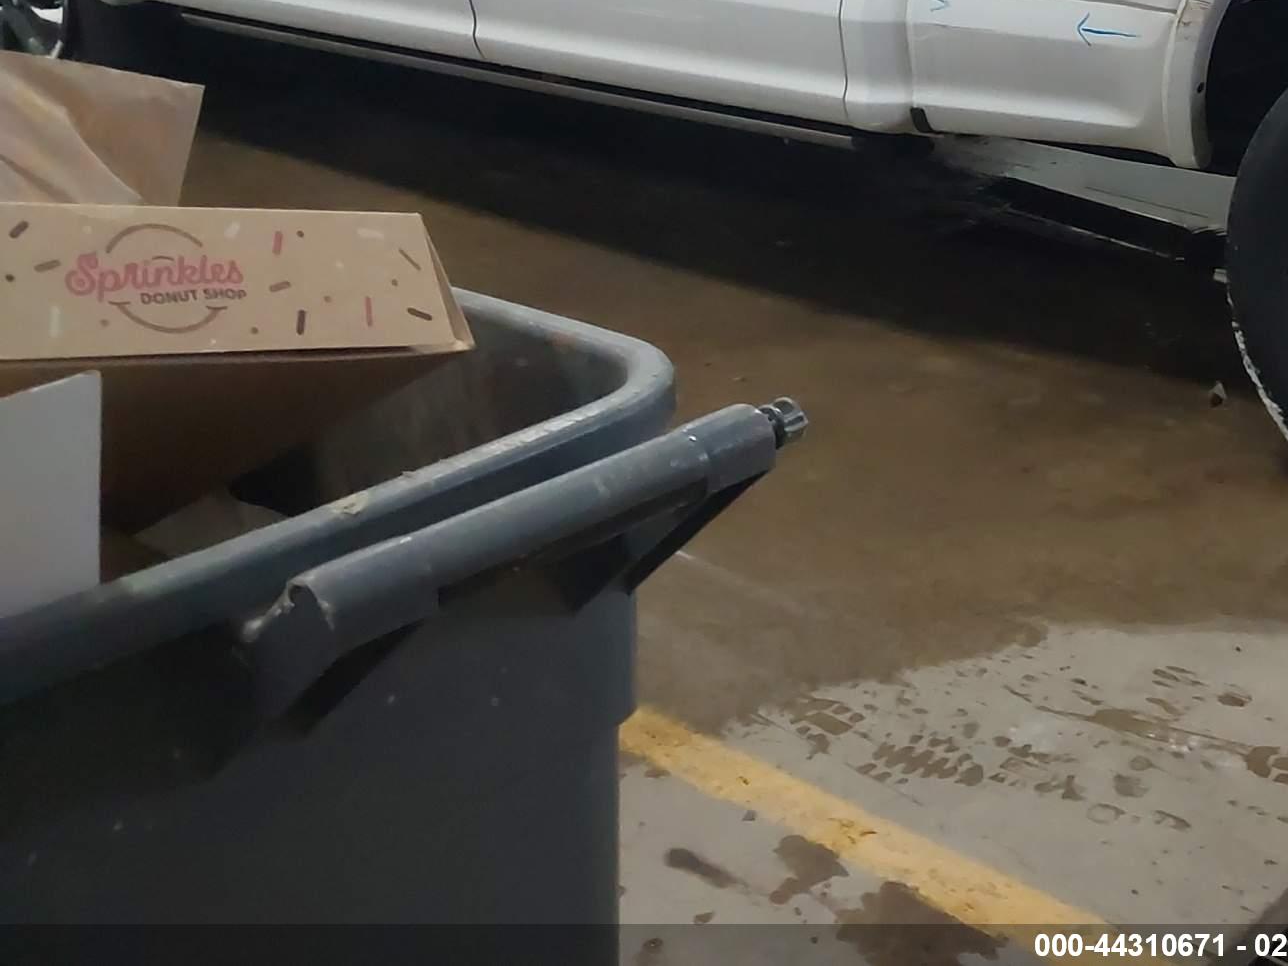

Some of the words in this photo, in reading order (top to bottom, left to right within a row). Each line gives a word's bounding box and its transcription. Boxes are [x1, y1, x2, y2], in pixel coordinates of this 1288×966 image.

[65, 252, 243, 302] Sprinkles
[140, 288, 198, 305] DONUT
[204, 287, 247, 300] SHOP
